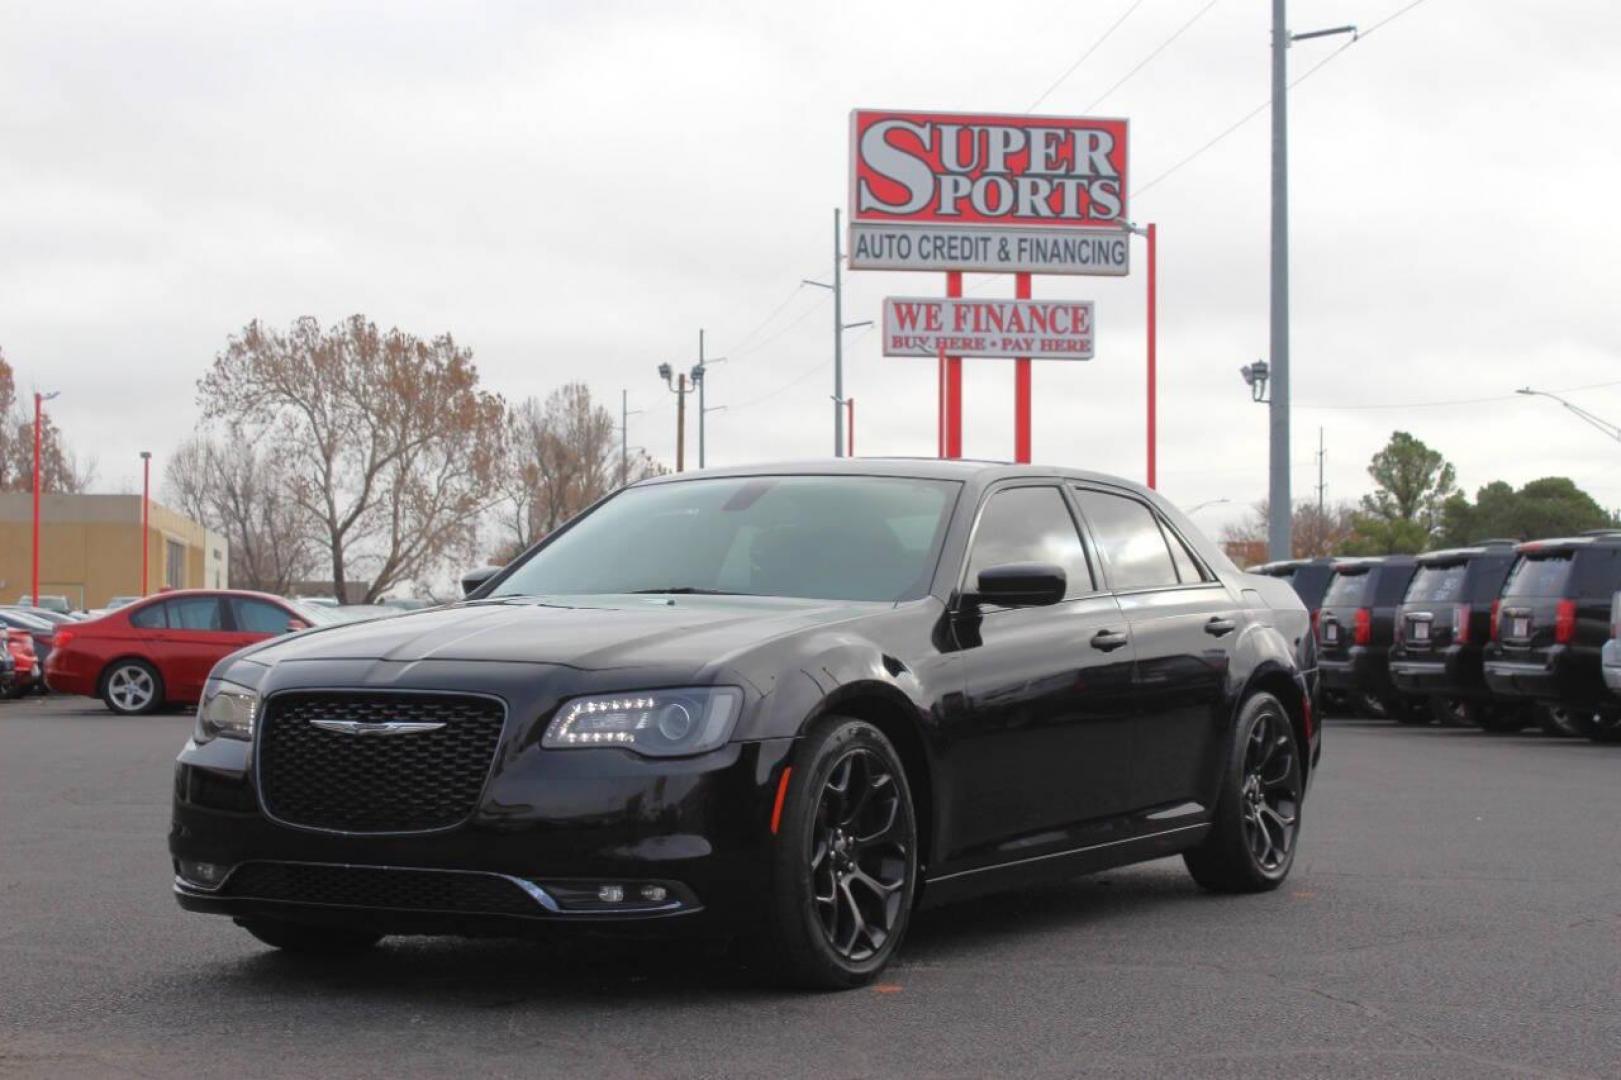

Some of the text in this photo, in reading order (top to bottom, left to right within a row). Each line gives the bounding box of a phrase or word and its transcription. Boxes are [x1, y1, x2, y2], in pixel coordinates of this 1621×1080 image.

[859, 117, 1119, 215] SUPER
[855, 233, 1125, 266] AUTO CREDIT & FINANCING
[892, 302, 1091, 334] WE FINANCE
[891, 335, 1092, 353] BUY HERE PAY HERE
